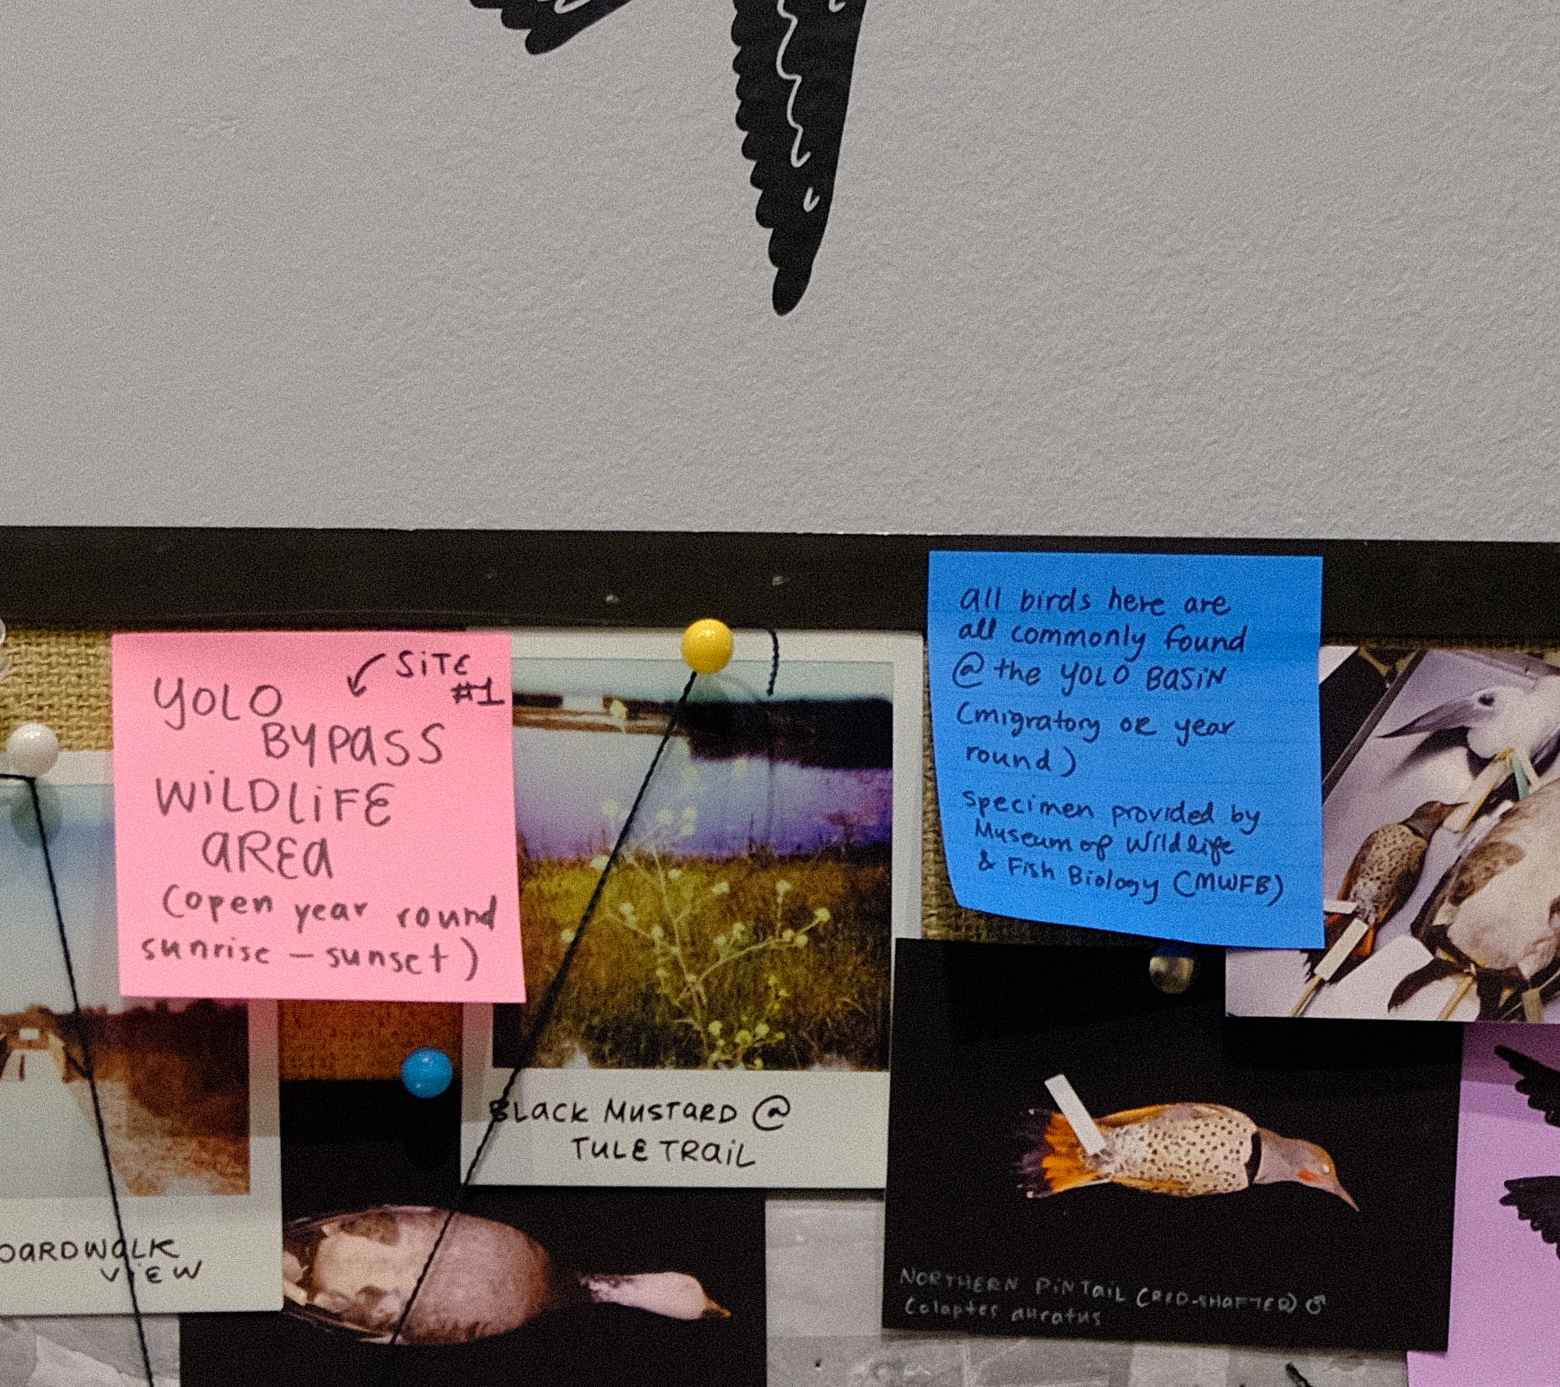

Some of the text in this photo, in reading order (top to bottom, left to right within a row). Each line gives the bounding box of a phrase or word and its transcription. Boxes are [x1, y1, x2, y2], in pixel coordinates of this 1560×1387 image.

[1020, 587, 1231, 615] birds here are
[958, 618, 1247, 661] all commonly found
[953, 652, 984, 688] @
[994, 659, 1040, 684] the
[451, 679, 505, 707] #1
[1009, 856, 1055, 879] Fish
[1069, 865, 1159, 904] Biology
[1174, 870, 1284, 907] (MWFB)
[163, 883, 498, 934] (open year round
[142, 931, 481, 982] sunrise sunset)
[753, 1094, 792, 1129] @
[572, 1138, 648, 1161] TULE
